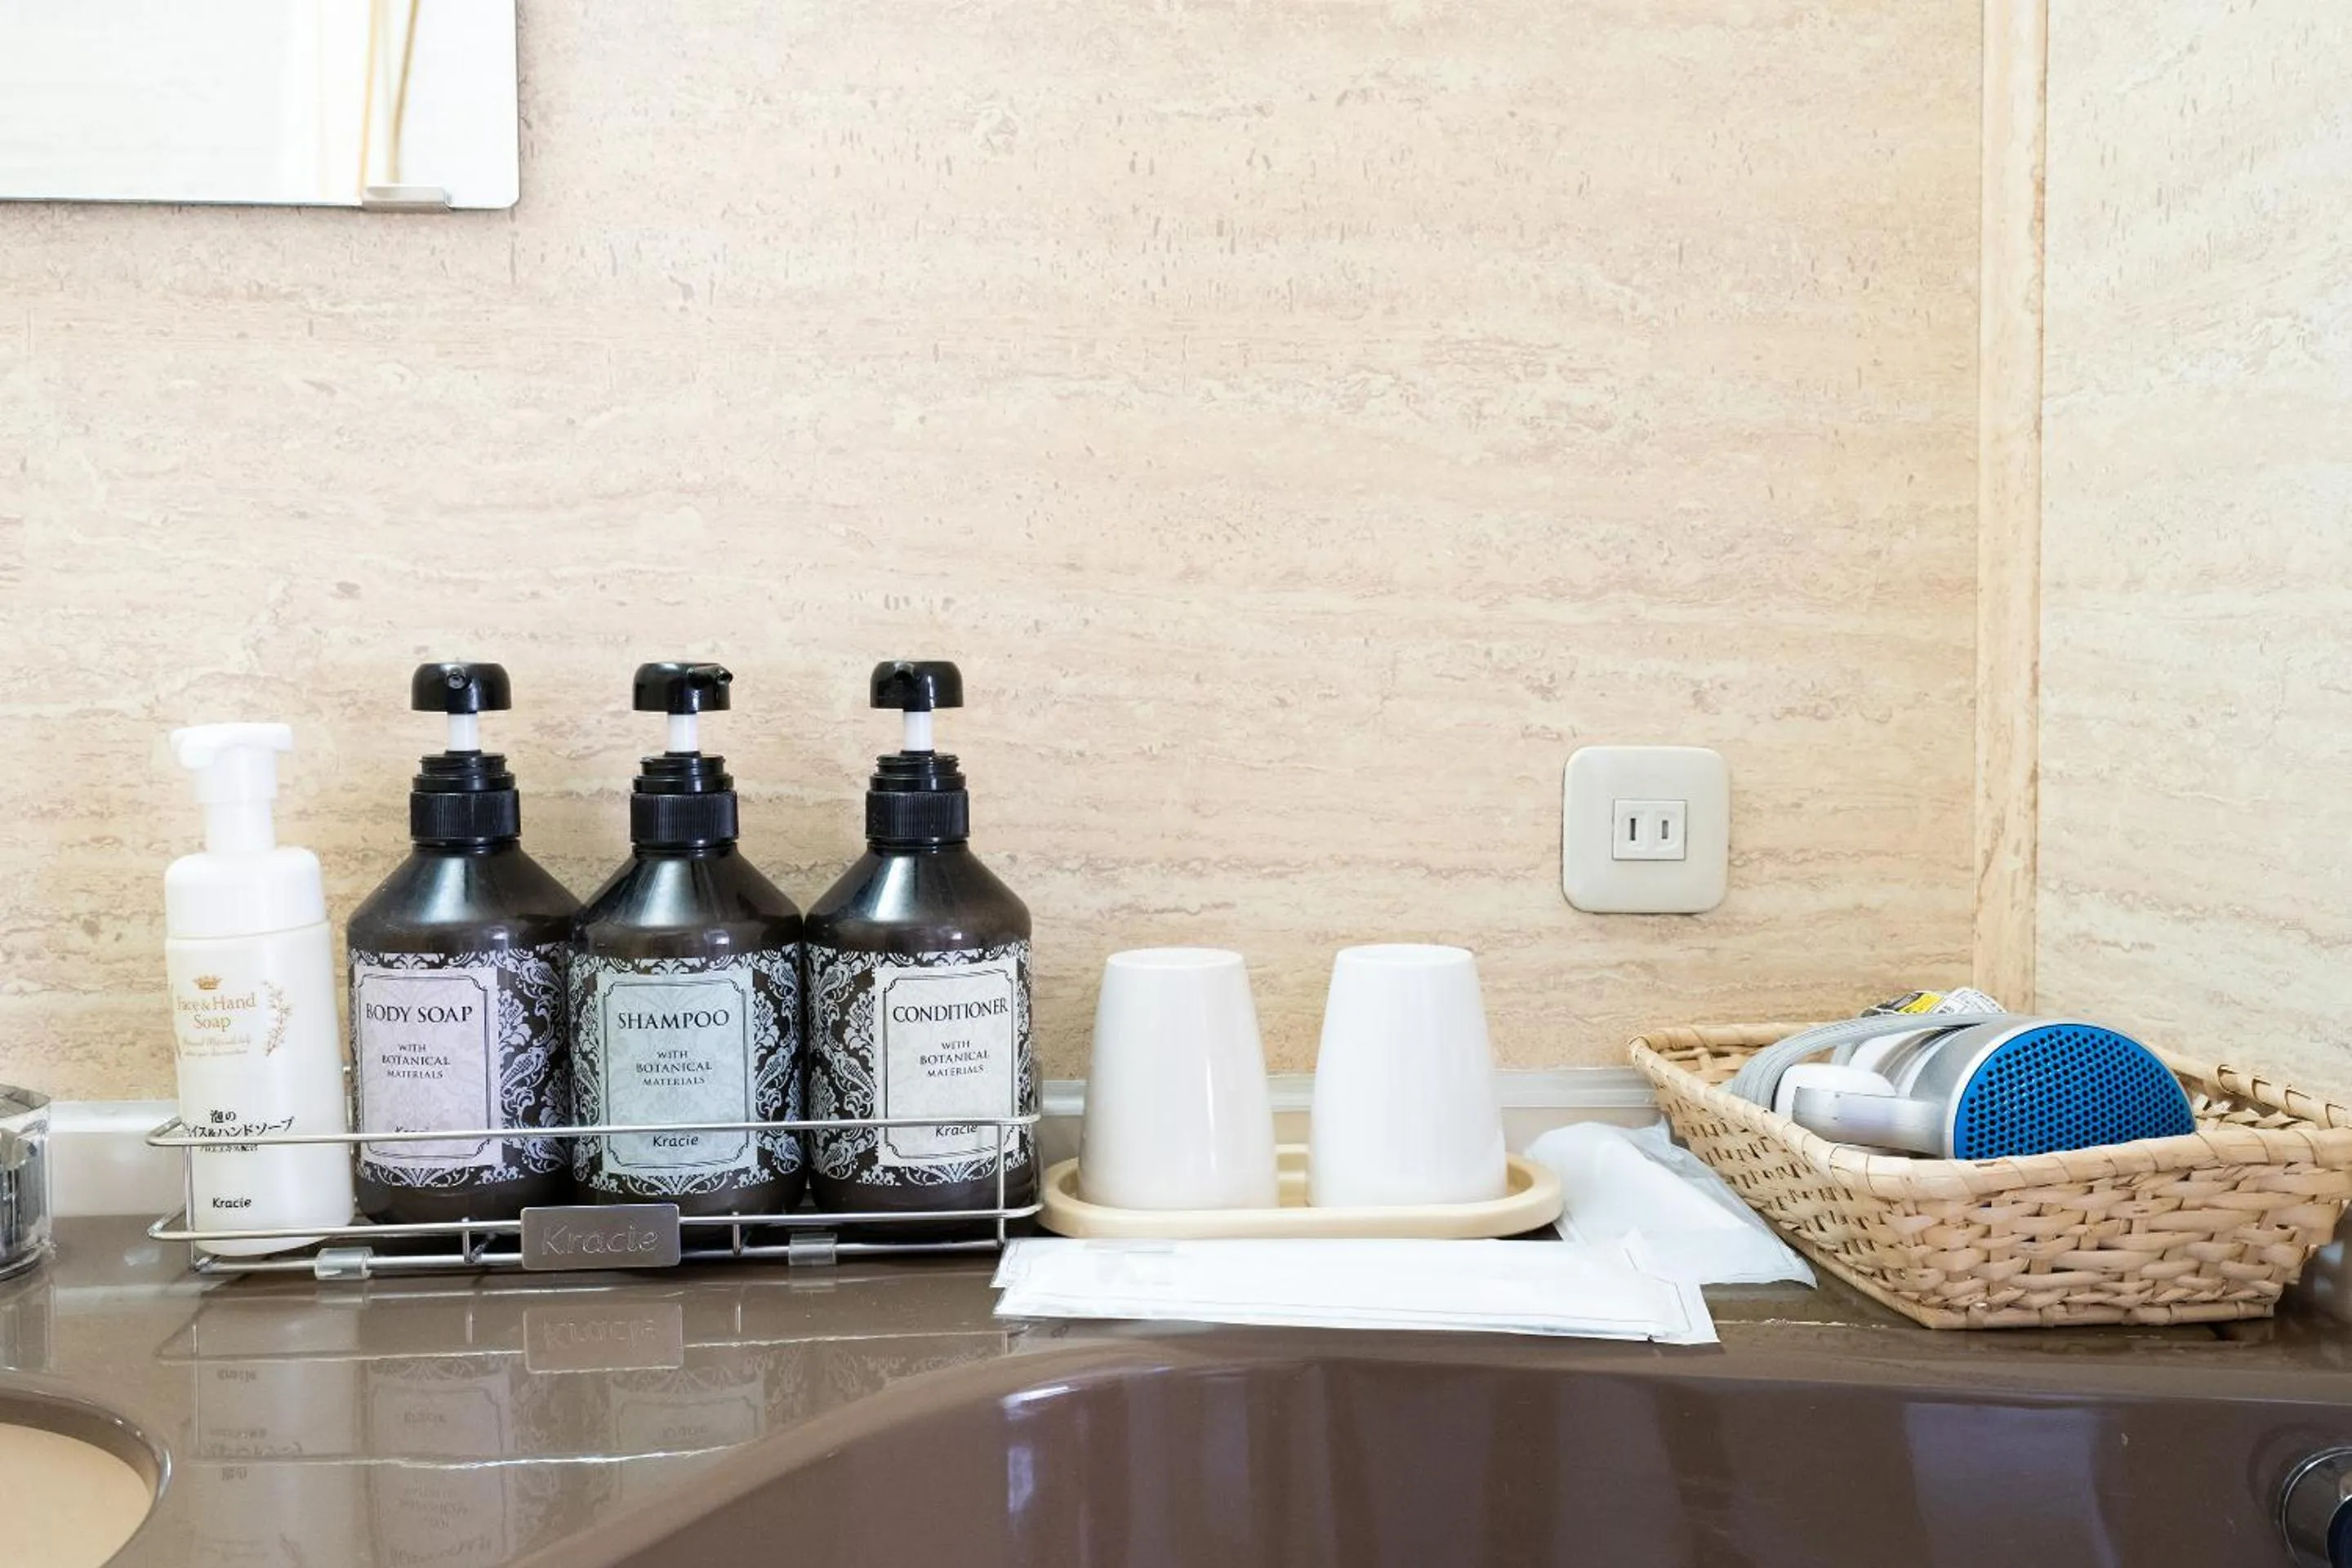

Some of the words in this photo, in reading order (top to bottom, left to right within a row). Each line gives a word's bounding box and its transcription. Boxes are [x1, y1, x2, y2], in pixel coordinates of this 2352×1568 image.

[212, 992, 257, 1011] Hand
[365, 1003, 412, 1022] BODY
[417, 1005, 473, 1023] SOAP
[893, 997, 1009, 1022] CONDITIONER
[193, 1014, 232, 1032] Soap
[618, 1009, 730, 1030] SHAMPOO
[397, 1044, 426, 1053] WITH
[941, 1040, 972, 1050] WITH
[381, 1054, 451, 1066] BOTANICAL
[657, 1050, 688, 1059] WITH
[920, 1050, 990, 1065] BOTANICAL
[635, 1061, 713, 1073] BOTANICAL
[927, 1065, 985, 1078] MATERIALS
[386, 1070, 443, 1080] MATERIALS
[642, 1077, 706, 1086] MATERIALS
[210, 1109, 237, 1123] 泡の
[935, 1125, 978, 1138] Kracie
[653, 1135, 699, 1147] Kracie
[212, 1197, 252, 1209] Kracie
[541, 1223, 660, 1255] Kracie
